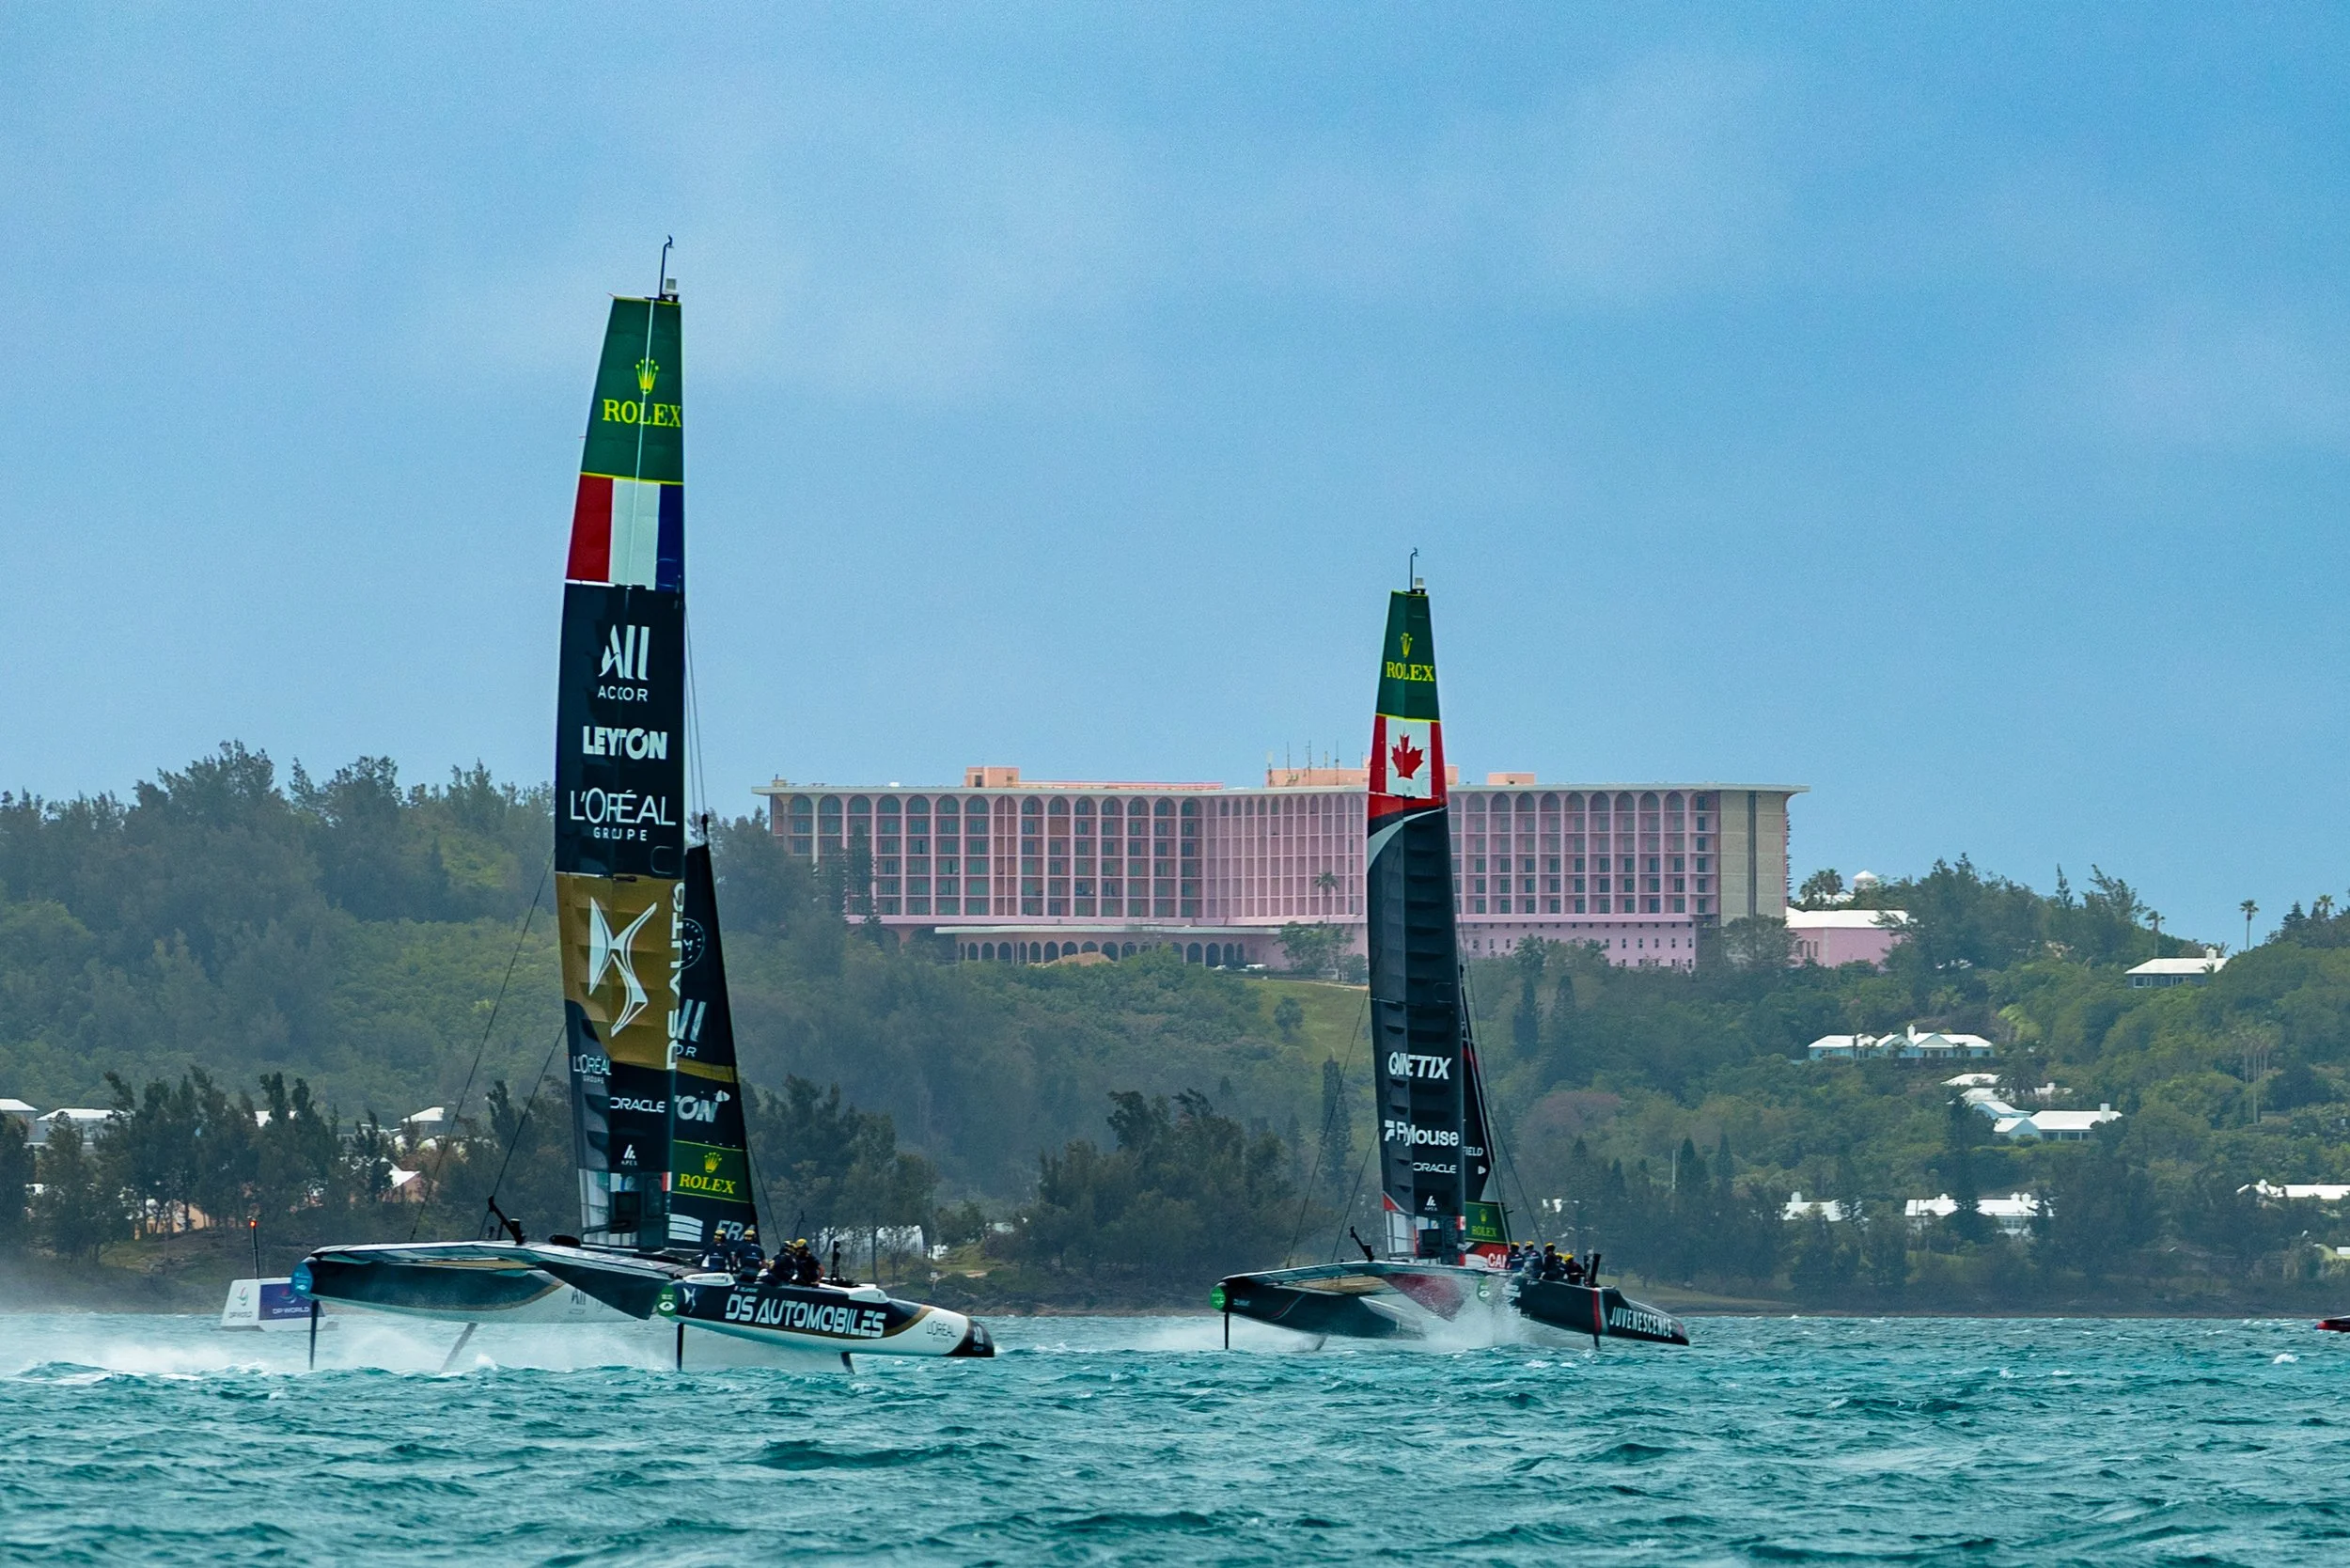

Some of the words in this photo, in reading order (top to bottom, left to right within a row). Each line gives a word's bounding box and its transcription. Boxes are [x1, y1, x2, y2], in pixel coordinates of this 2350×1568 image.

[602, 399, 682, 428] ROLEX
[1386, 661, 1435, 682] ROLEX
[598, 685, 649, 701] ACCOR
[583, 726, 667, 760] LEYTON
[570, 788, 677, 825] L'ORÉAL
[572, 1054, 612, 1075] L'ORÉAL
[610, 1096, 666, 1113] ORACLE
[1413, 1162, 1457, 1173] ORACLE
[679, 1173, 736, 1194] ROLEX
[1471, 1225, 1496, 1237] ROLEX
[725, 1294, 757, 1321] DS
[755, 1297, 887, 1339] AUTOMOBILES
[1608, 1307, 1672, 1338] JUVENESCENCE
